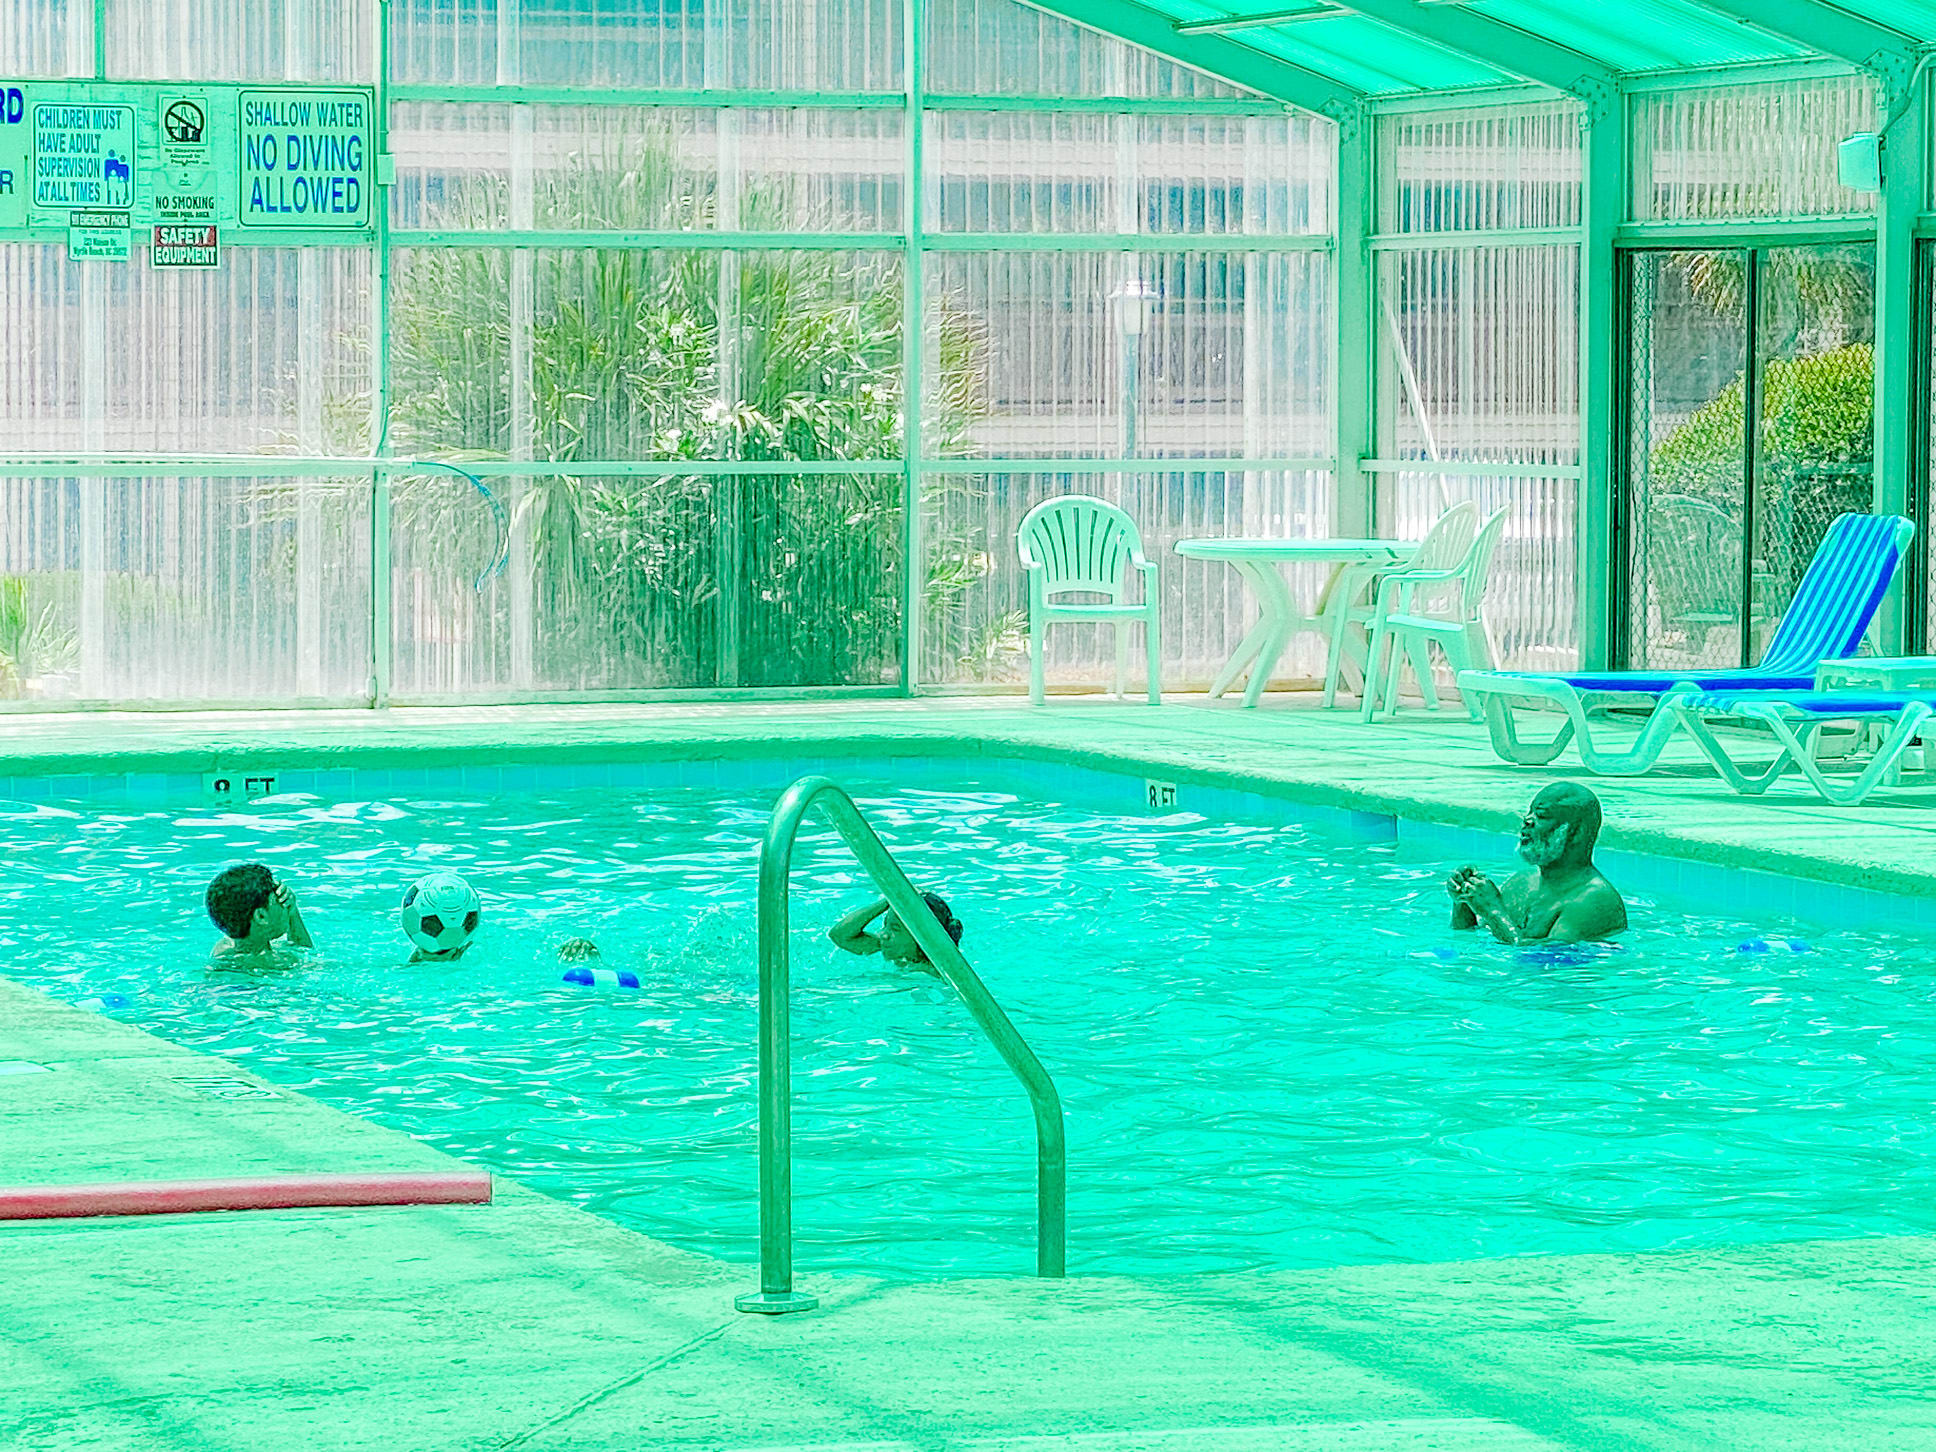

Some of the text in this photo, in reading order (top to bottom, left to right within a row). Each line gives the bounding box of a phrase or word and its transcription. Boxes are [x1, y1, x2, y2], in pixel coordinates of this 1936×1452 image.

[38, 108, 122, 130] CHILDREN MUST
[246, 101, 363, 127] SHALLOW WATER
[38, 132, 101, 154] HAVE ADULT
[247, 134, 362, 172] NO DIVING
[38, 157, 100, 178] SUPERVISION
[38, 181, 101, 202] AT ALL TIMES
[155, 195, 215, 210] NO SMOKING
[249, 176, 360, 214] ALLOWED
[160, 227, 211, 245] SAFETY
[155, 246, 216, 264] EQUIPMENT
[1149, 785, 1157, 808] 8
